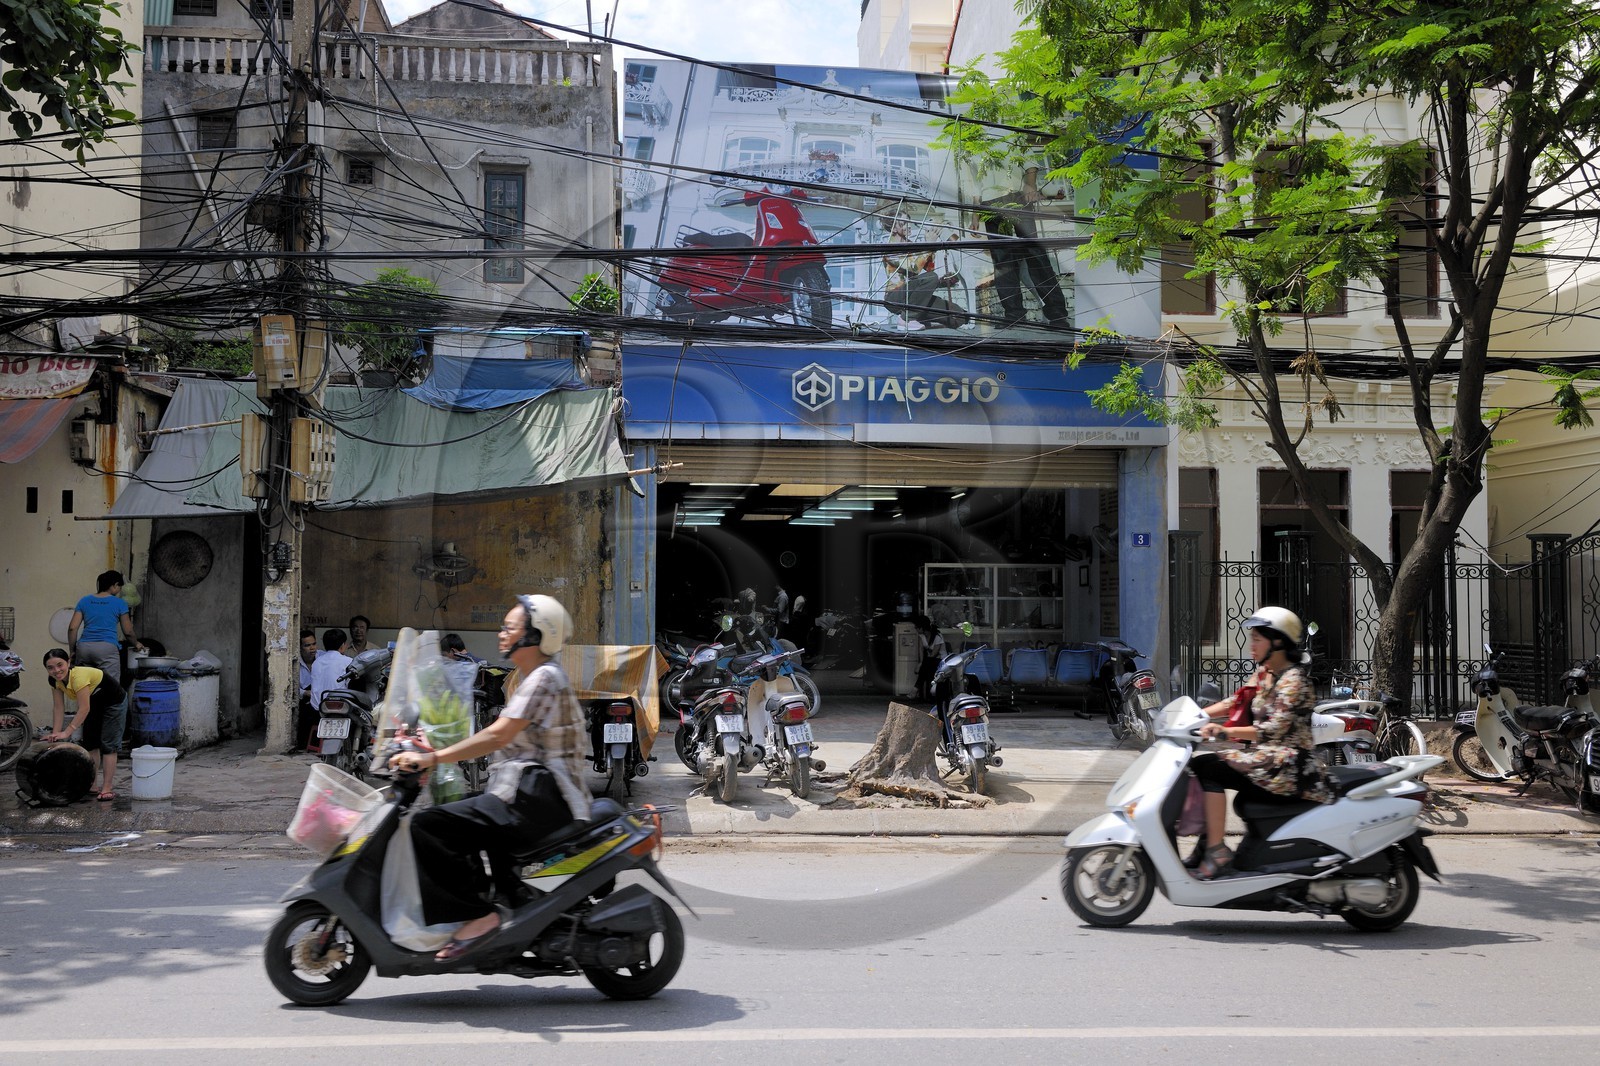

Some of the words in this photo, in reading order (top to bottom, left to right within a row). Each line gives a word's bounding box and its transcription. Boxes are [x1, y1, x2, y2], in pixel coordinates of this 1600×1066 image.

[839, 375, 1000, 403] PIAGGIO
[1137, 534, 1144, 545] 3
[608, 733, 629, 742] 2664
[967, 732, 987, 743] 5159
